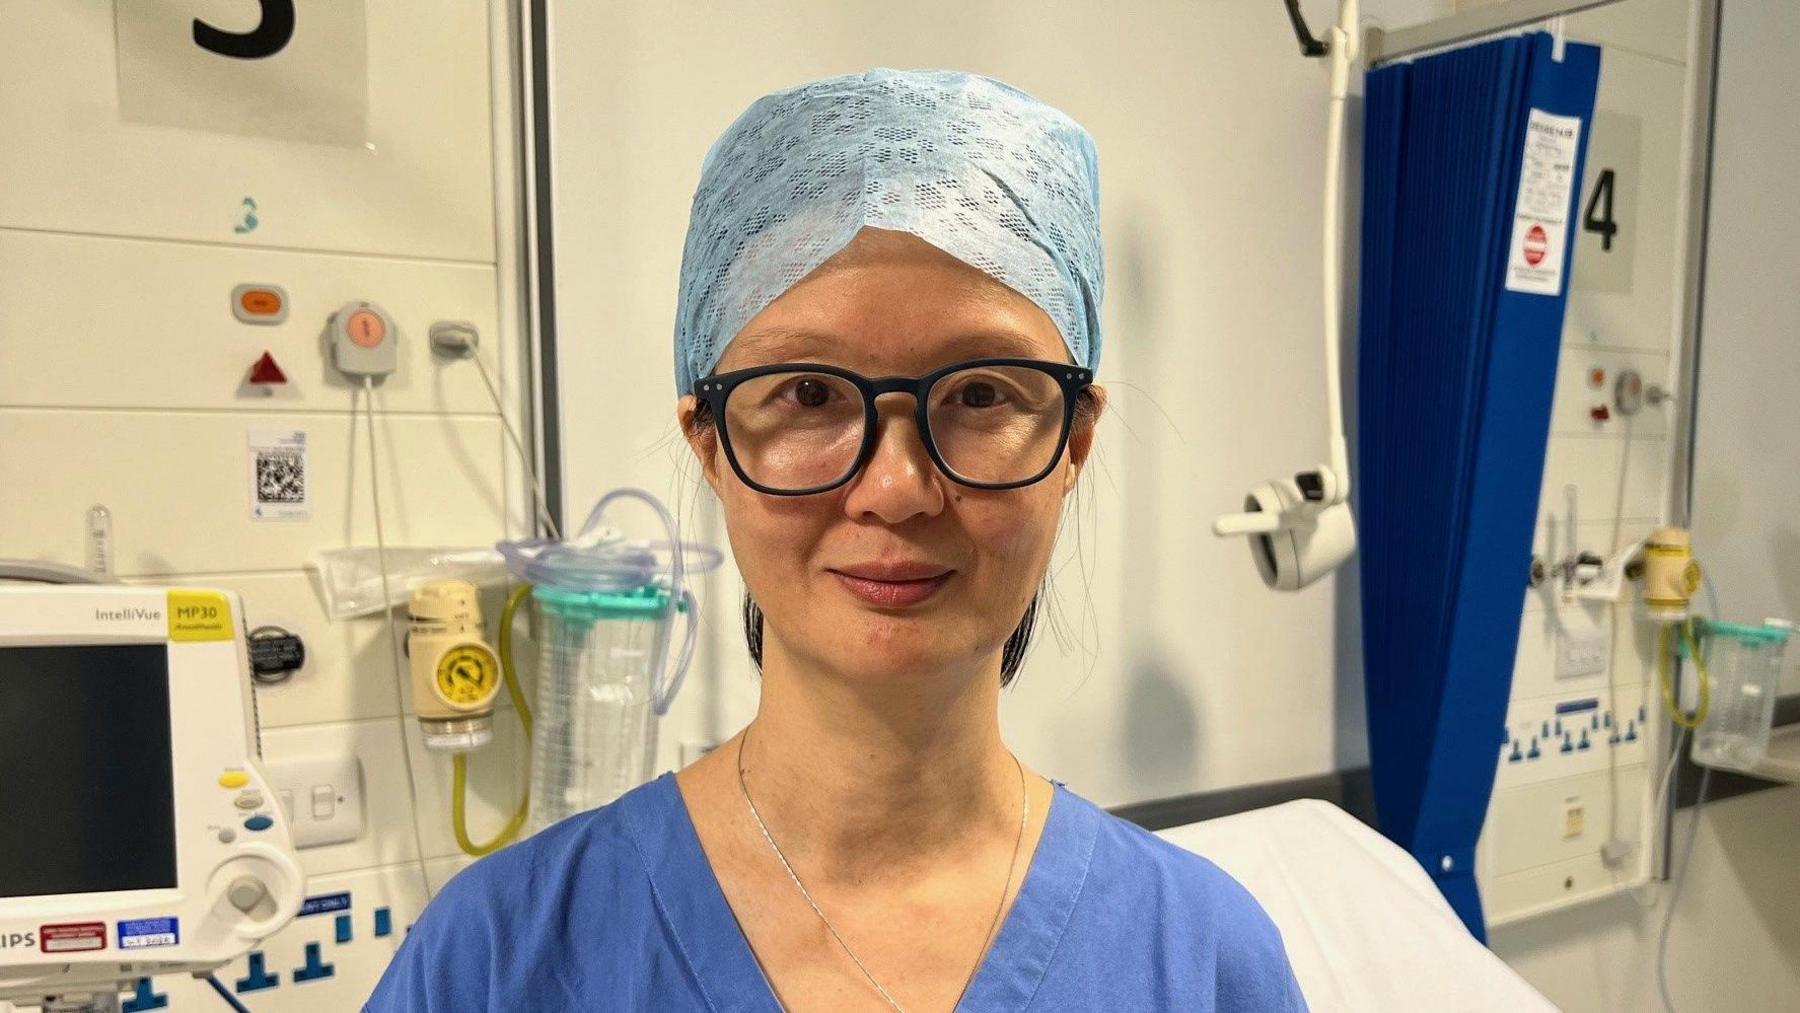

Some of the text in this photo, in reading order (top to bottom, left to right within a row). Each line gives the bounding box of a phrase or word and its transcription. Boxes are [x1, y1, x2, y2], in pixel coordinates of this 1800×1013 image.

[1583, 169, 1617, 251] 4
[95, 608, 161, 621] IntelliVue
[176, 606, 217, 619] MP30
